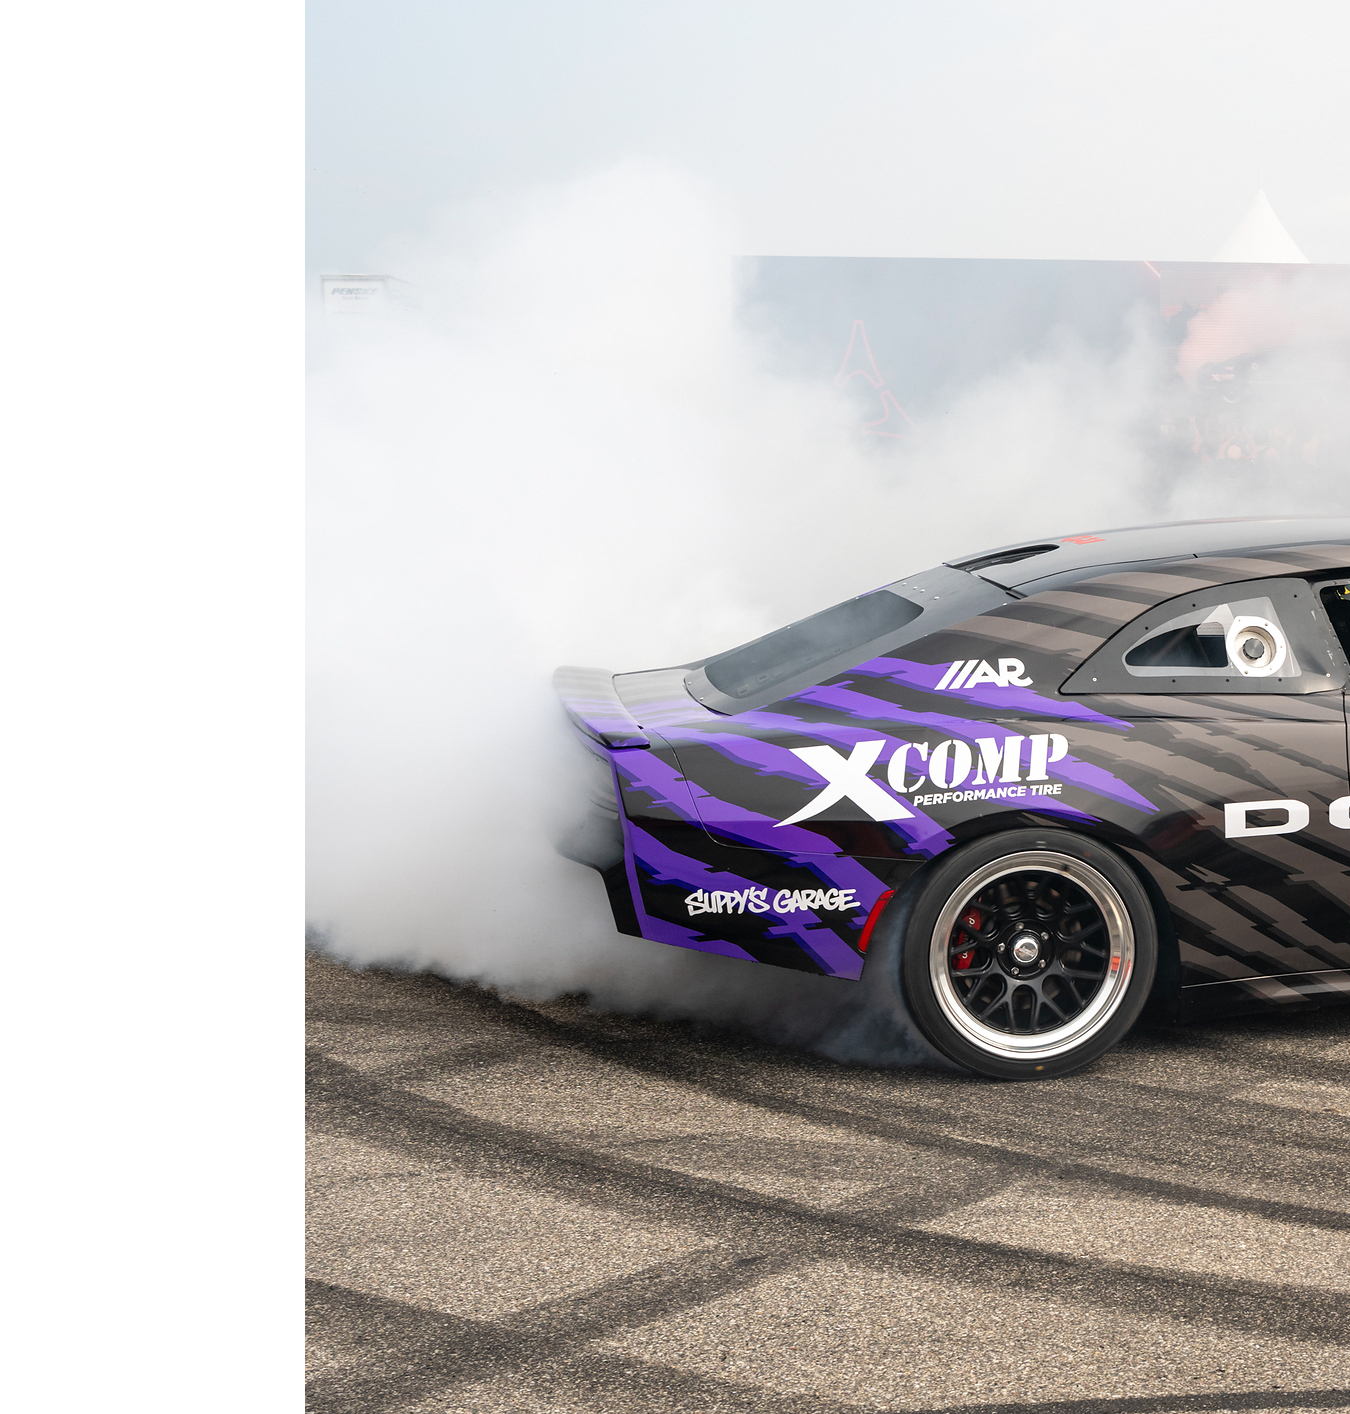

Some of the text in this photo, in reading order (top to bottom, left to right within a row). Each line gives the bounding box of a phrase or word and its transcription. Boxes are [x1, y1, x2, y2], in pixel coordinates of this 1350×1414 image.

[913, 784, 1062, 806] PERFORMANCE TIRE
[684, 886, 861, 916] SUPPY'S GARAGE
